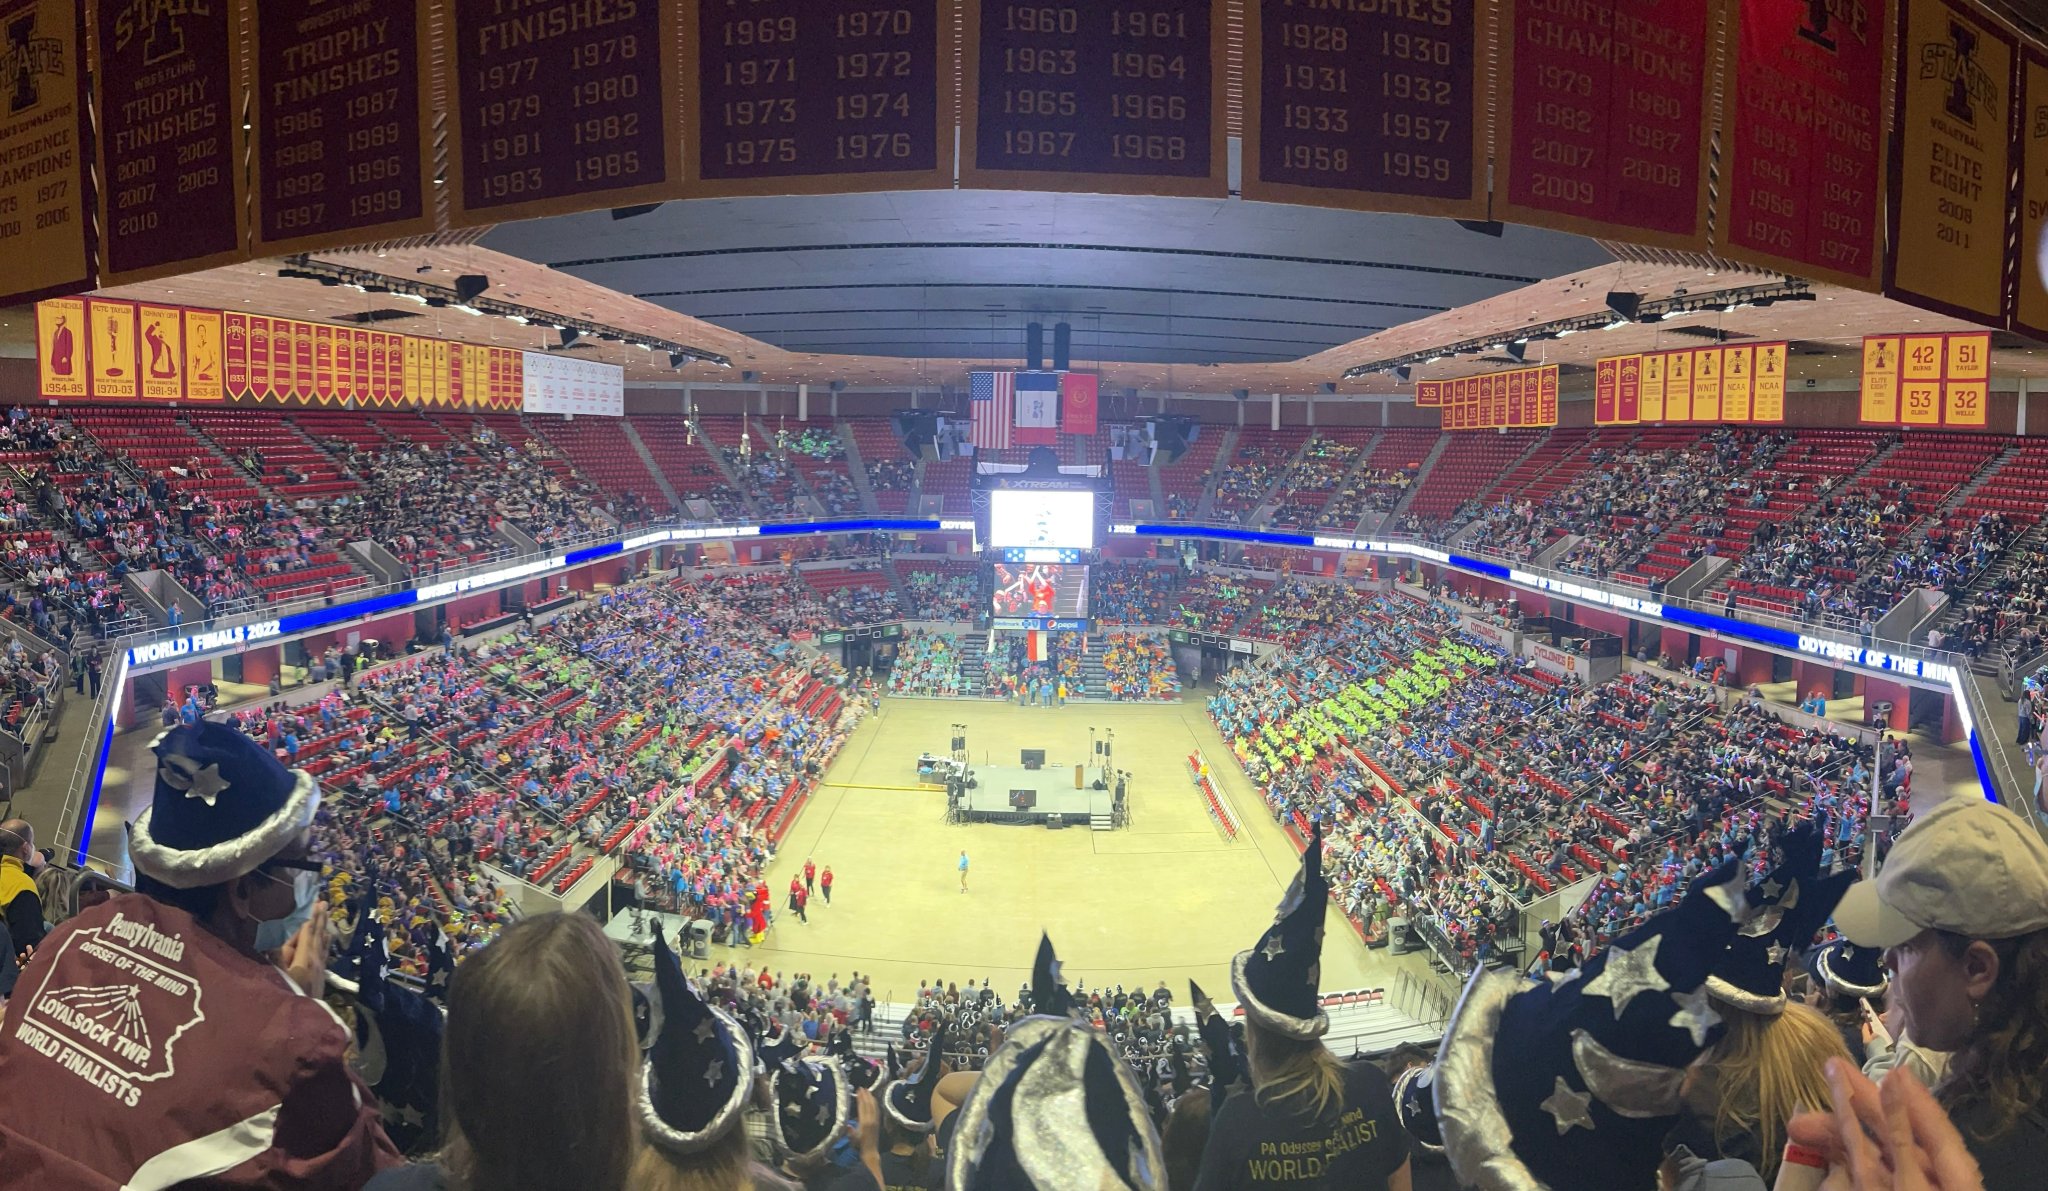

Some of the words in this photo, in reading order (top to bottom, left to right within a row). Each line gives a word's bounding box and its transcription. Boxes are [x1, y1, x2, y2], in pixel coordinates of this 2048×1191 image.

[480, 0, 637, 55] FINISHES
[724, 17, 797, 46] 1969
[837, 9, 911, 38] 1970
[1004, 5, 1078, 34] 1960
[1111, 9, 1185, 38] 1961
[282, 16, 389, 72] TROPHY
[1283, 23, 1347, 51] 1928
[1382, 30, 1450, 65] 1930
[1527, 18, 1693, 85] CHAMPIONS
[134, 59, 196, 91] WRESTLING
[273, 48, 401, 106] FINISHES
[480, 57, 539, 92] 1977
[572, 35, 637, 70] 1978
[724, 57, 795, 85] 1971
[837, 51, 911, 80] 1972
[1005, 47, 1077, 75] 1963
[1112, 51, 1186, 79] 1964
[122, 75, 208, 124] TROPHY
[480, 94, 540, 127] 1979
[572, 74, 638, 108] 1980
[1285, 64, 1347, 93] 1931
[1382, 71, 1451, 105] 1932
[1538, 64, 1592, 96] 1979
[1629, 88, 1681, 120] 1980
[274, 108, 323, 137] 1986
[346, 87, 399, 119] 1987
[724, 98, 797, 126] 1973
[837, 92, 909, 120] 1974
[1004, 89, 1077, 116] 1965
[1112, 94, 1186, 120] 1966
[1746, 86, 1872, 152] CHAMPIONS
[115, 103, 217, 154] FINISHES
[481, 131, 541, 163] 1981
[574, 112, 639, 145] 1982
[1285, 104, 1348, 133] 1933
[1382, 112, 1450, 142] 1957
[1538, 101, 1591, 133] 1982
[1627, 123, 1681, 153] 1987
[1930, 117, 1984, 153] VOLLEYBALL
[117, 156, 156, 182] 2000
[177, 137, 217, 165] 2002
[274, 140, 324, 168] 1988
[347, 122, 399, 153] 1989
[724, 138, 797, 165] 1975
[837, 133, 911, 160] 1976
[1004, 130, 1076, 157] 1967
[1112, 134, 1185, 161] 1968
[1284, 145, 1348, 172] 1958
[1383, 152, 1450, 181] 1959
[1532, 138, 1593, 168] 2007
[1623, 157, 1681, 188] 2008
[1931, 142, 1982, 180] ELITE
[37, 180, 67, 204] 1977
[118, 183, 157, 209] 2007
[178, 166, 219, 194] 2009
[275, 172, 325, 199] 1992
[348, 155, 401, 185] 1996
[483, 167, 542, 198] 1983
[575, 151, 639, 181] 1985
[1532, 173, 1593, 204] 2009
[1752, 157, 1793, 187] 1941
[1823, 181, 1862, 208] 1947
[1930, 165, 1982, 202] EIGHT
[119, 212, 158, 236] 2010
[275, 203, 326, 229] 1997
[350, 189, 401, 217] 1999
[1821, 210, 1861, 236] 1970
[1938, 197, 1972, 224] 2008
[1747, 219, 1793, 248] 1976
[1819, 240, 1860, 266] 1977
[1938, 222, 1970, 249] 2011
[1912, 345, 1935, 364] 42
[1959, 345, 1977, 363] 51
[45, 383, 83, 393] 1954-85
[97, 384, 133, 394] 1970-03
[147, 385, 178, 395] 1981-94
[1422, 387, 1436, 397] 35
[1696, 383, 1718, 393] WNIT
[1727, 383, 1746, 391] NCAA
[1759, 382, 1780, 390] NCAA
[1909, 390, 1932, 408] 53
[1954, 390, 1978, 409] 32
[1012, 480, 1069, 489] XTREAM
[1113, 524, 1136, 534] 2022
[1609, 593, 1639, 611] FINALS
[1639, 601, 1662, 617] 2022
[133, 638, 190, 664] WORLD
[192, 626, 245, 652] FINALS
[246, 620, 281, 640] 2022
[1057, 621, 1079, 630] pepsi
[1470, 622, 1496, 640] CYCLONES
[1534, 645, 1566, 667] CYCLONES
[1798, 635, 1865, 663] ODYSSEY
[1865, 649, 1888, 668] OF
[1890, 654, 1920, 676] THE
[115, 956, 135, 971] OF
[131, 963, 159, 982] THE
[154, 975, 188, 997] MIND
[37, 995, 117, 1047] LOYALSOCK
[113, 1034, 151, 1069] TWP.
[15, 1022, 61, 1058] WORLD
[55, 1047, 142, 1107] FINALISTS
[1261, 1141, 1278, 1156] PA
[1248, 1157, 1322, 1181] WORLD
